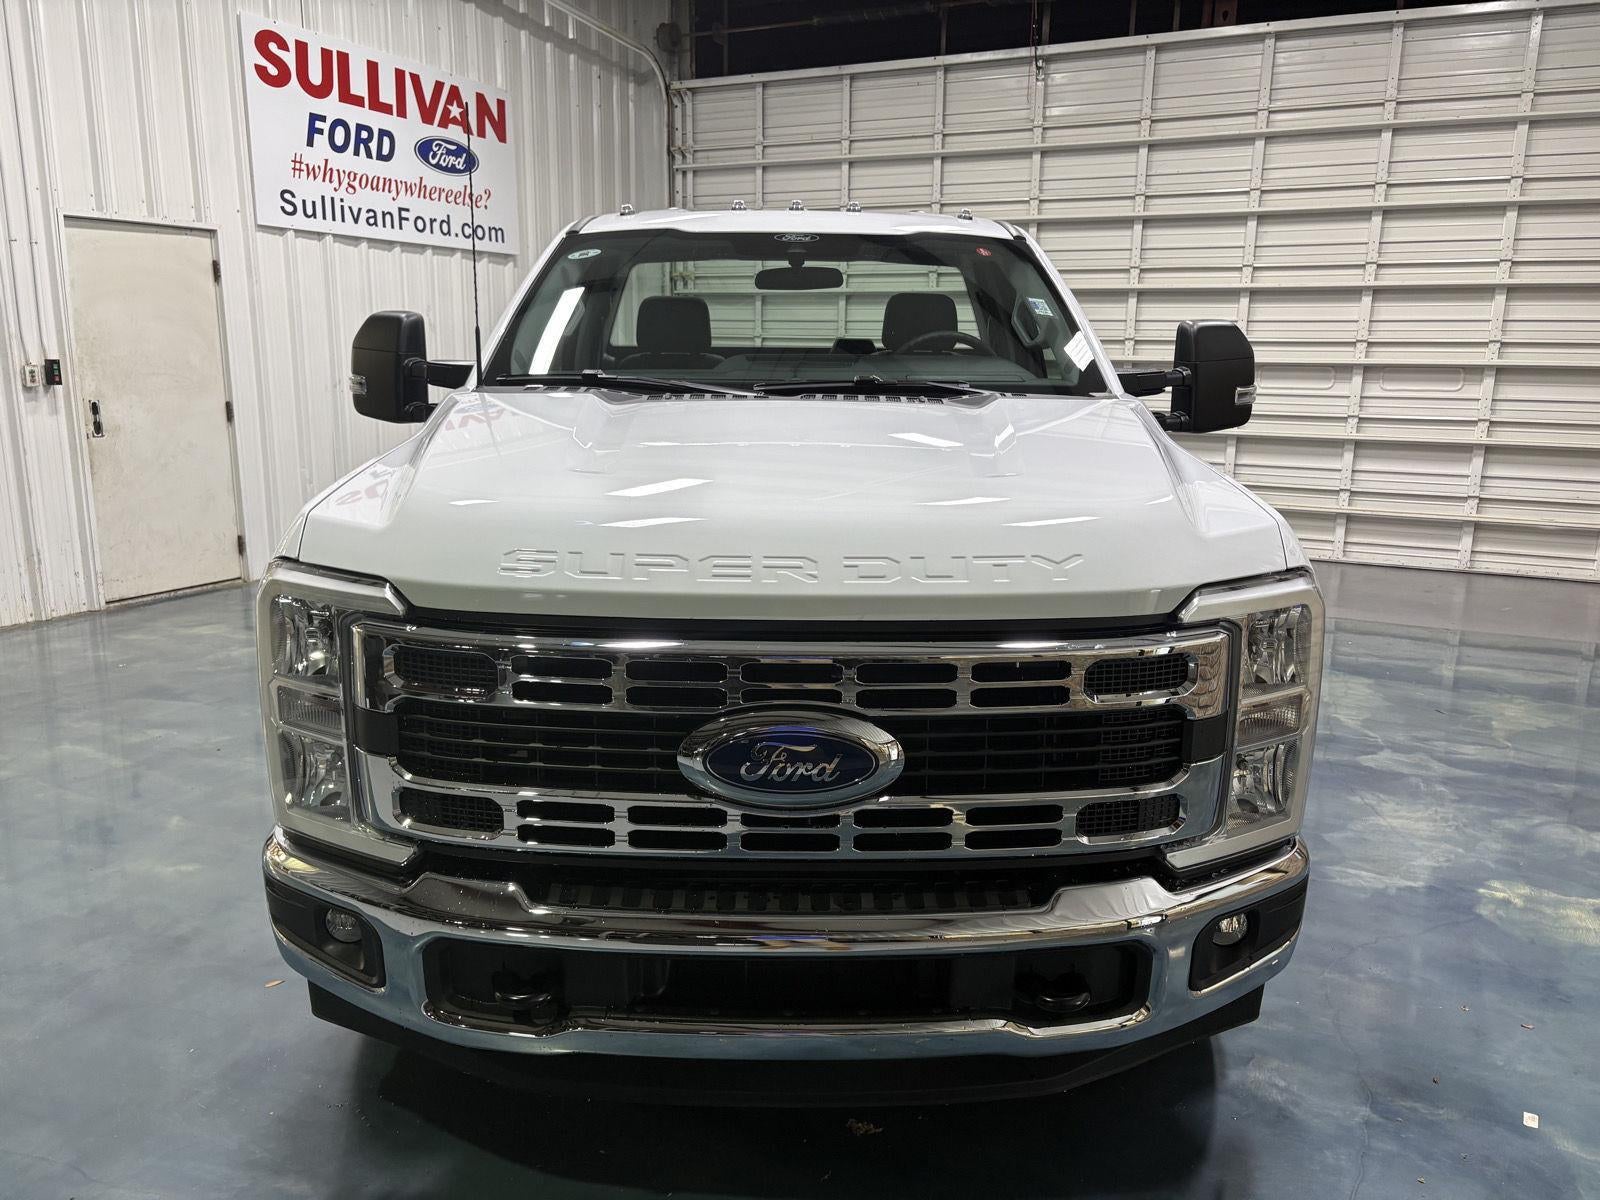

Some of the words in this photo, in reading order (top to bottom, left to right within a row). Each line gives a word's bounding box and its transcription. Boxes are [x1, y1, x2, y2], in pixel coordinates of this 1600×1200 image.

[253, 29, 507, 144] SULLIVAN
[306, 112, 396, 163] FORD
[428, 140, 467, 171] Ford
[279, 188, 505, 244] SullivanFord.com
[498, 548, 818, 583] SUPER
[843, 554, 1084, 583] DUTY
[740, 741, 844, 782] Ford
